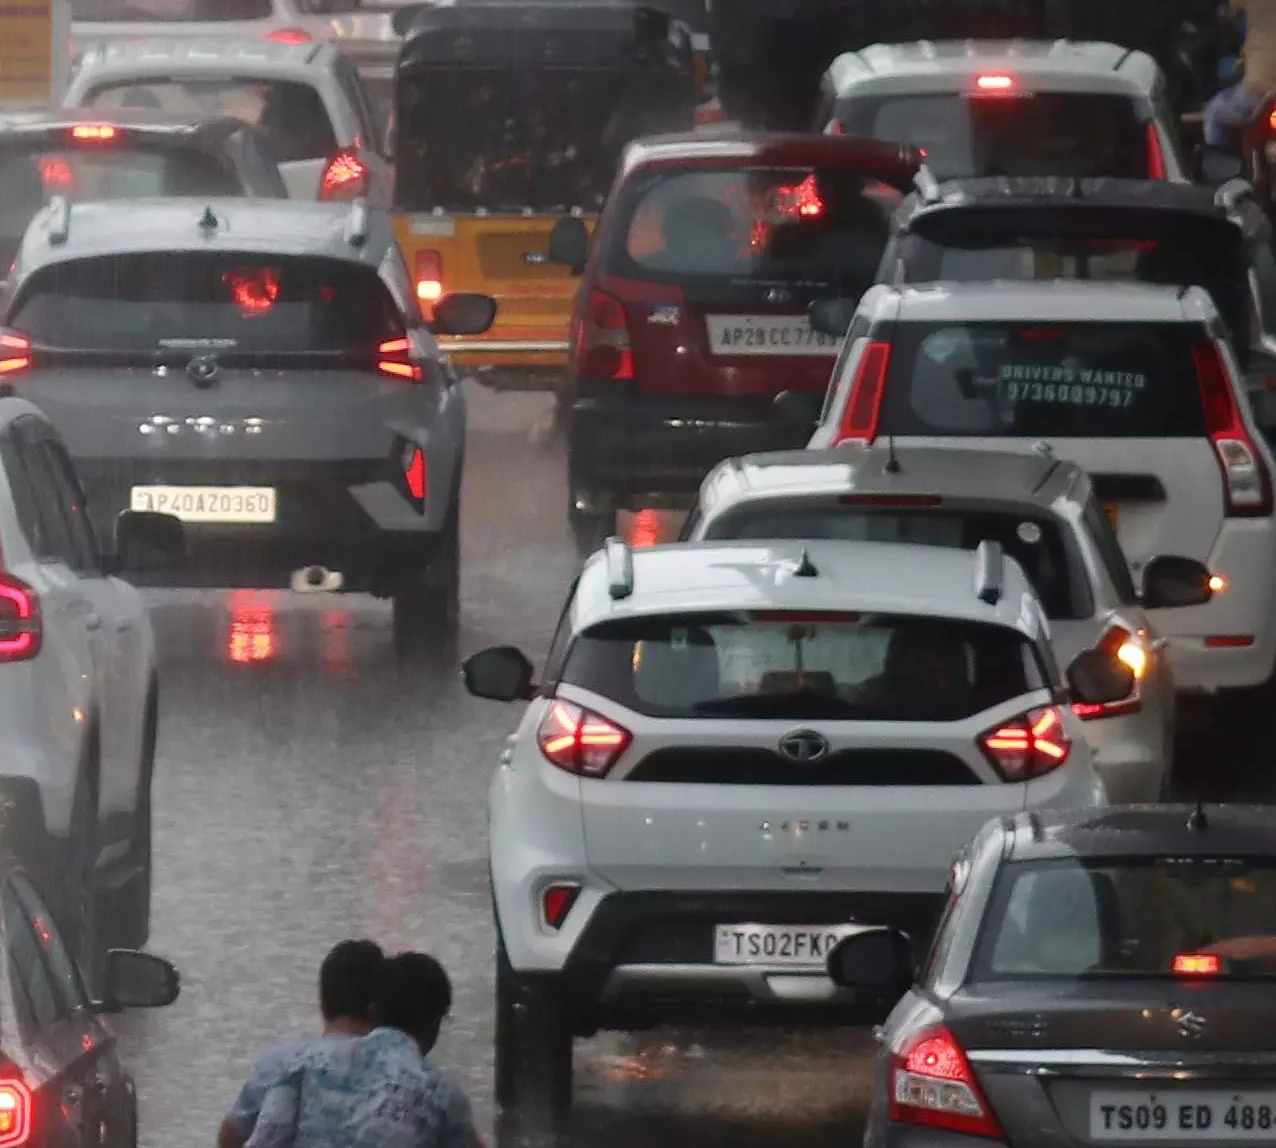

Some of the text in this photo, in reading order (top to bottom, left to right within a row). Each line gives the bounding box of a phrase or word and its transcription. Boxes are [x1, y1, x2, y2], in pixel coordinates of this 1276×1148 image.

[1001, 364, 1146, 389] DRIVERS WANTED
[1099, 1105, 1276, 1130] TS09 ED 488
